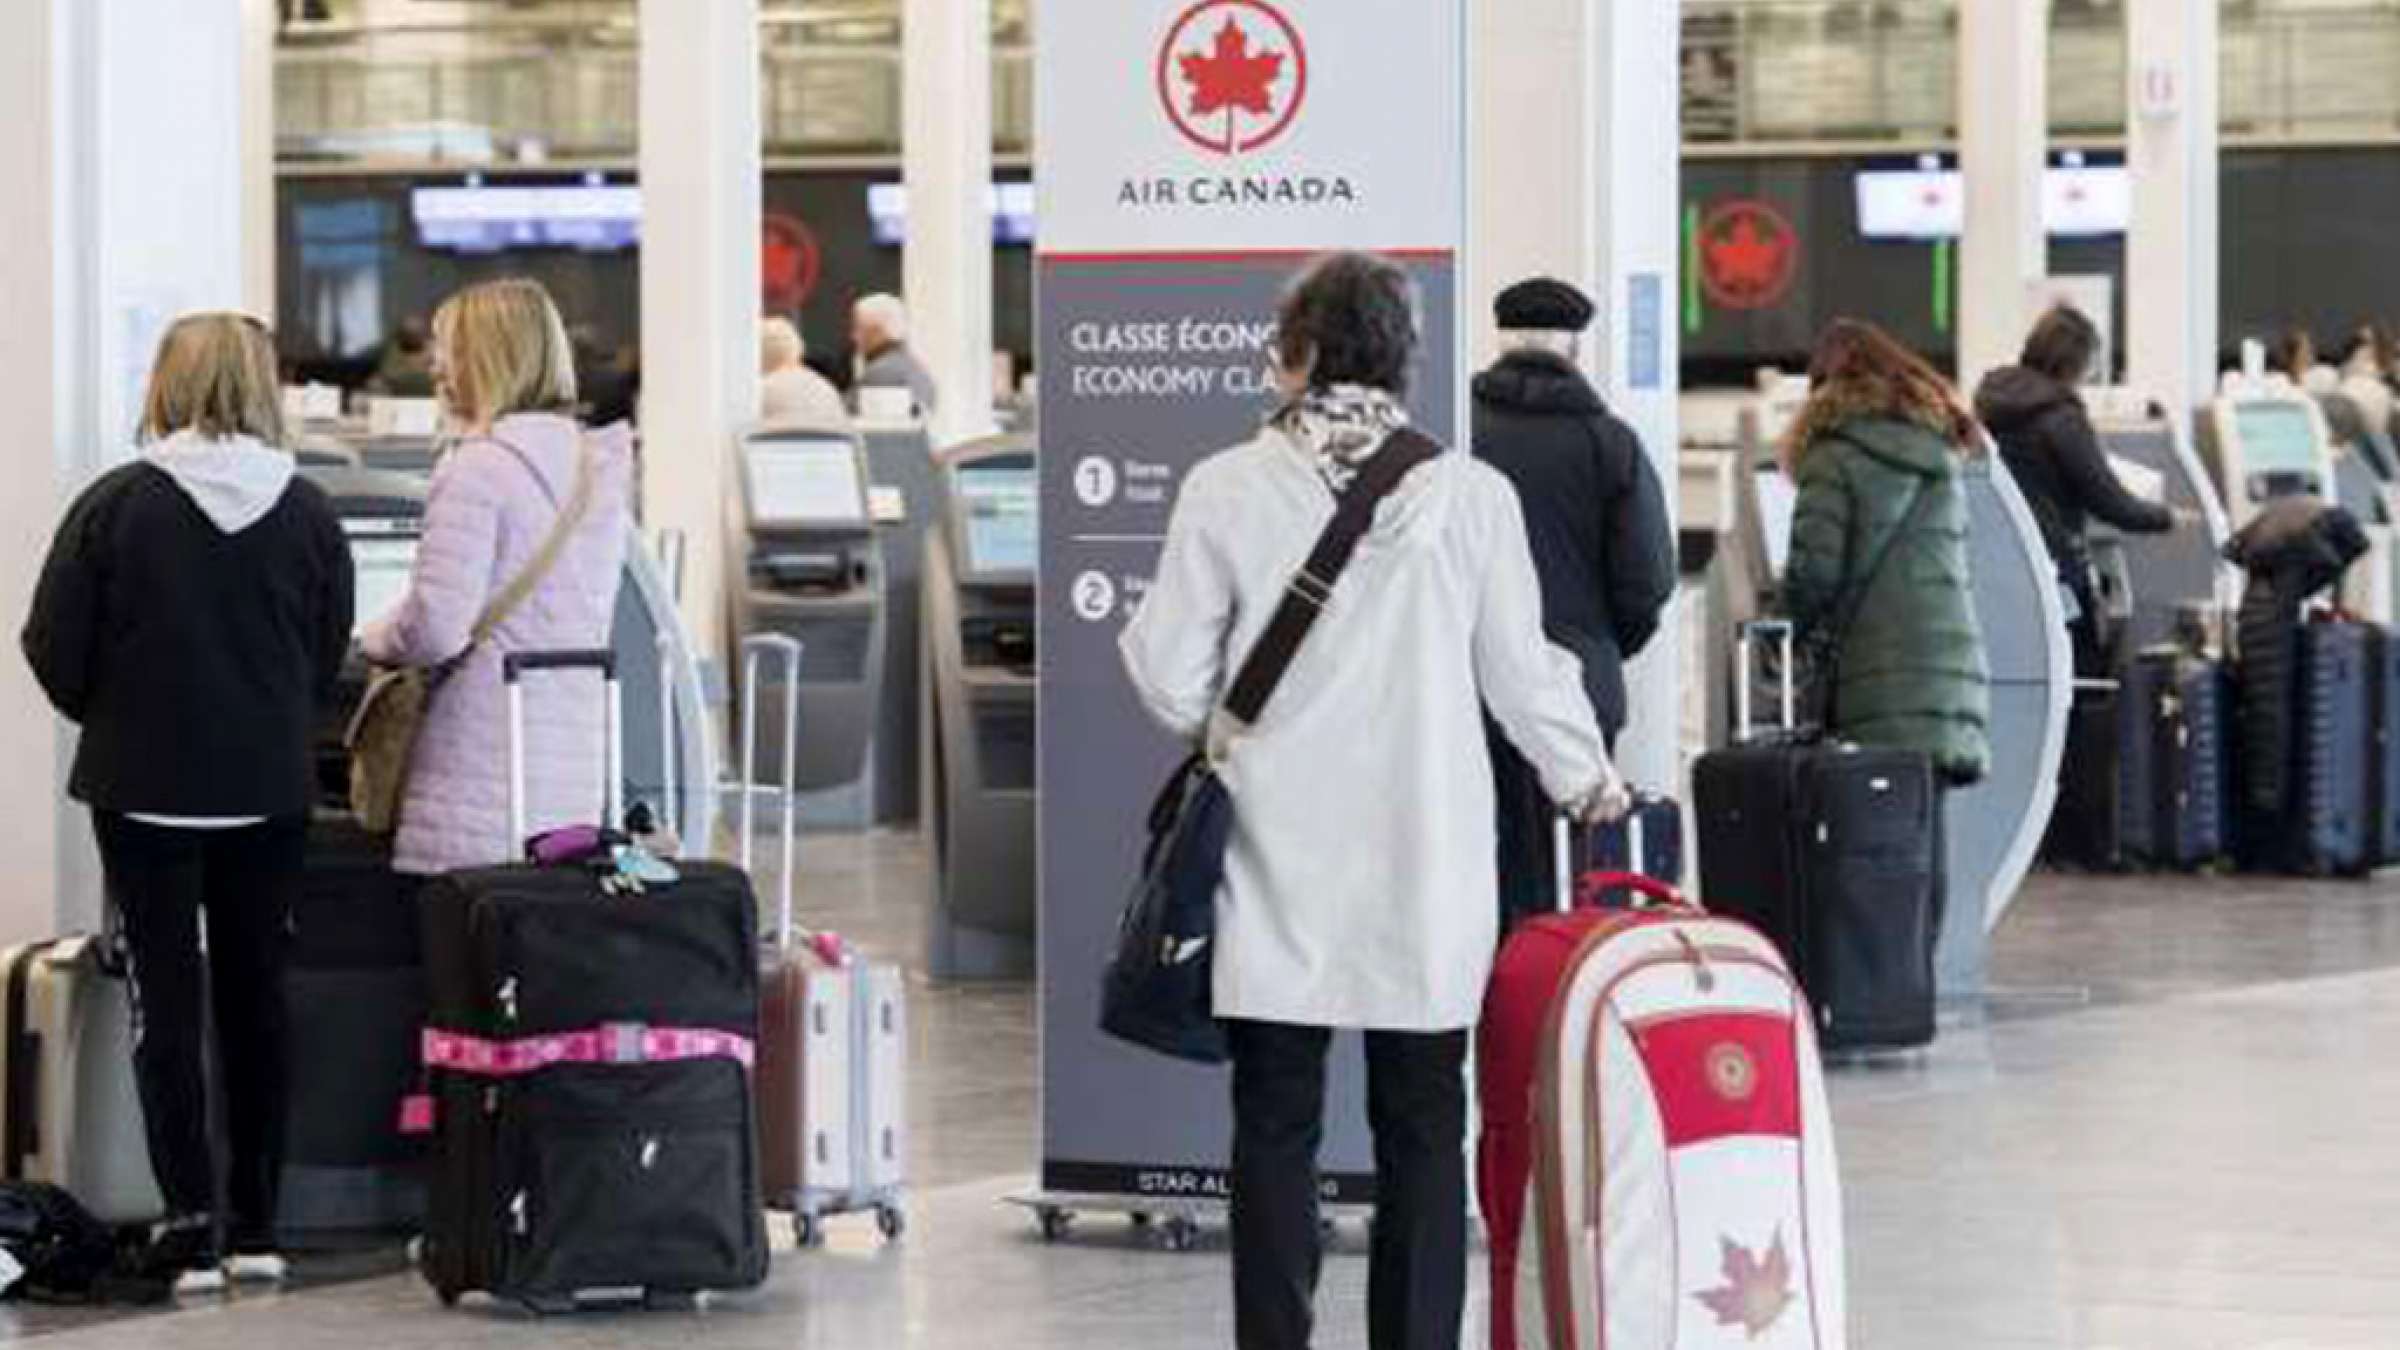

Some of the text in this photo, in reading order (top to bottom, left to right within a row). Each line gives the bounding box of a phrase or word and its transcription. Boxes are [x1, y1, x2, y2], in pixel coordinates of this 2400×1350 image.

[1118, 177, 1355, 205] AIR CANADA
[1070, 322, 1170, 352] CLASSE
[1072, 366, 1214, 395] ECONOMY
